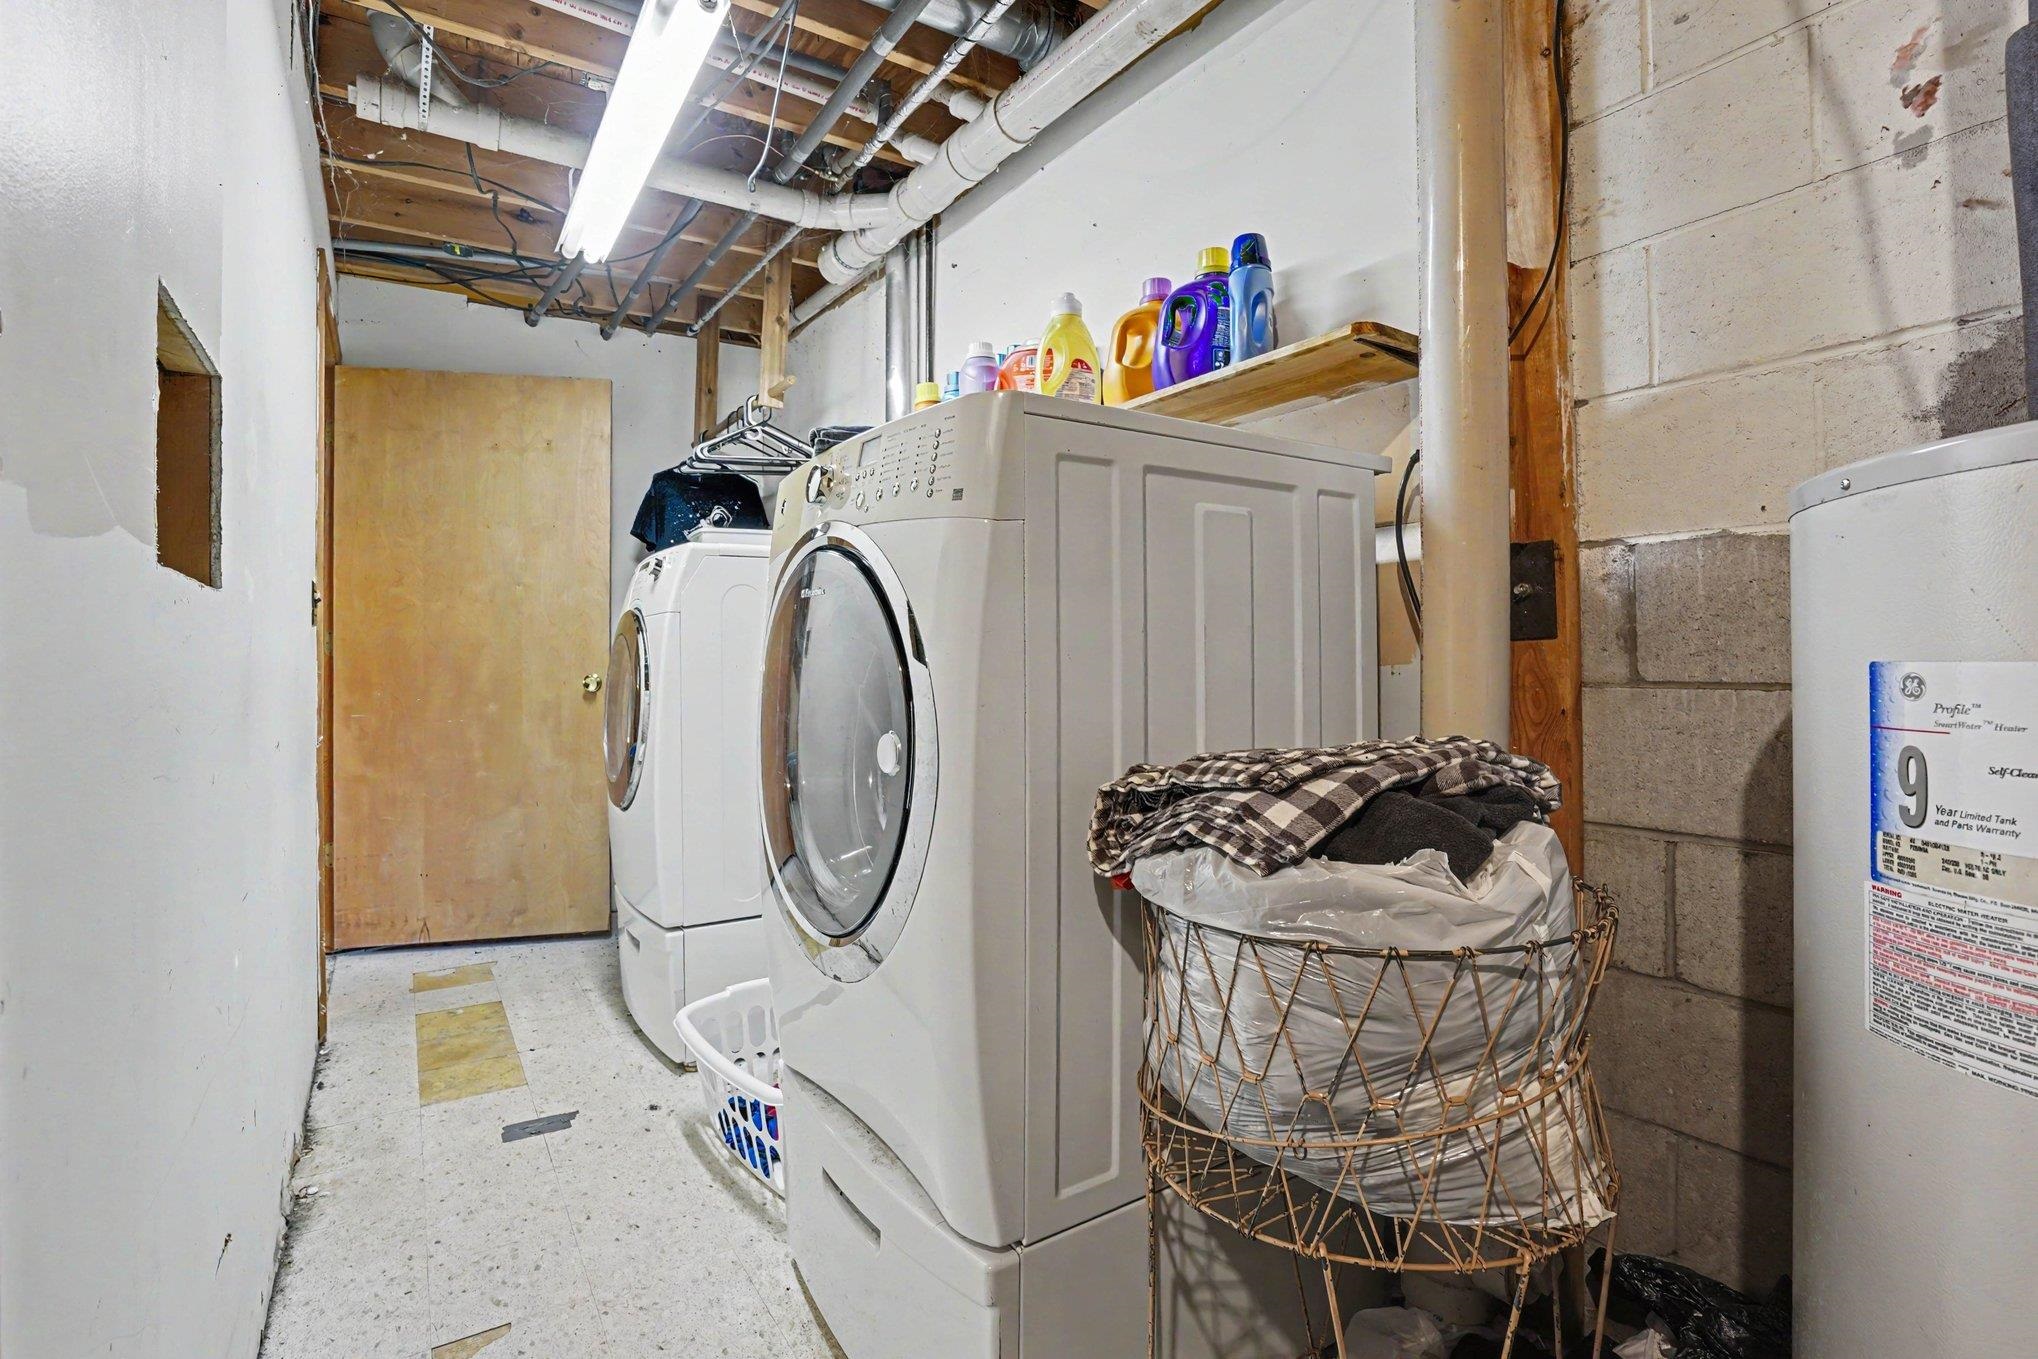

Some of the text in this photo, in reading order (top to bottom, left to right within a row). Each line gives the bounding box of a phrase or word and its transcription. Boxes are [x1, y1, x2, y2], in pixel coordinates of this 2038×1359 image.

[1994, 723, 2028, 733] Heater
[1898, 745, 1928, 829] 9
[1935, 805, 2017, 826] Year Limited Tank
[1934, 818, 2022, 839] and Parts Warranty
[1871, 884, 1903, 899] WARNING
[1928, 901, 1956, 912] ELECTRIC
[1957, 906, 1979, 917] WATER
[1981, 914, 2008, 924] HEATER
